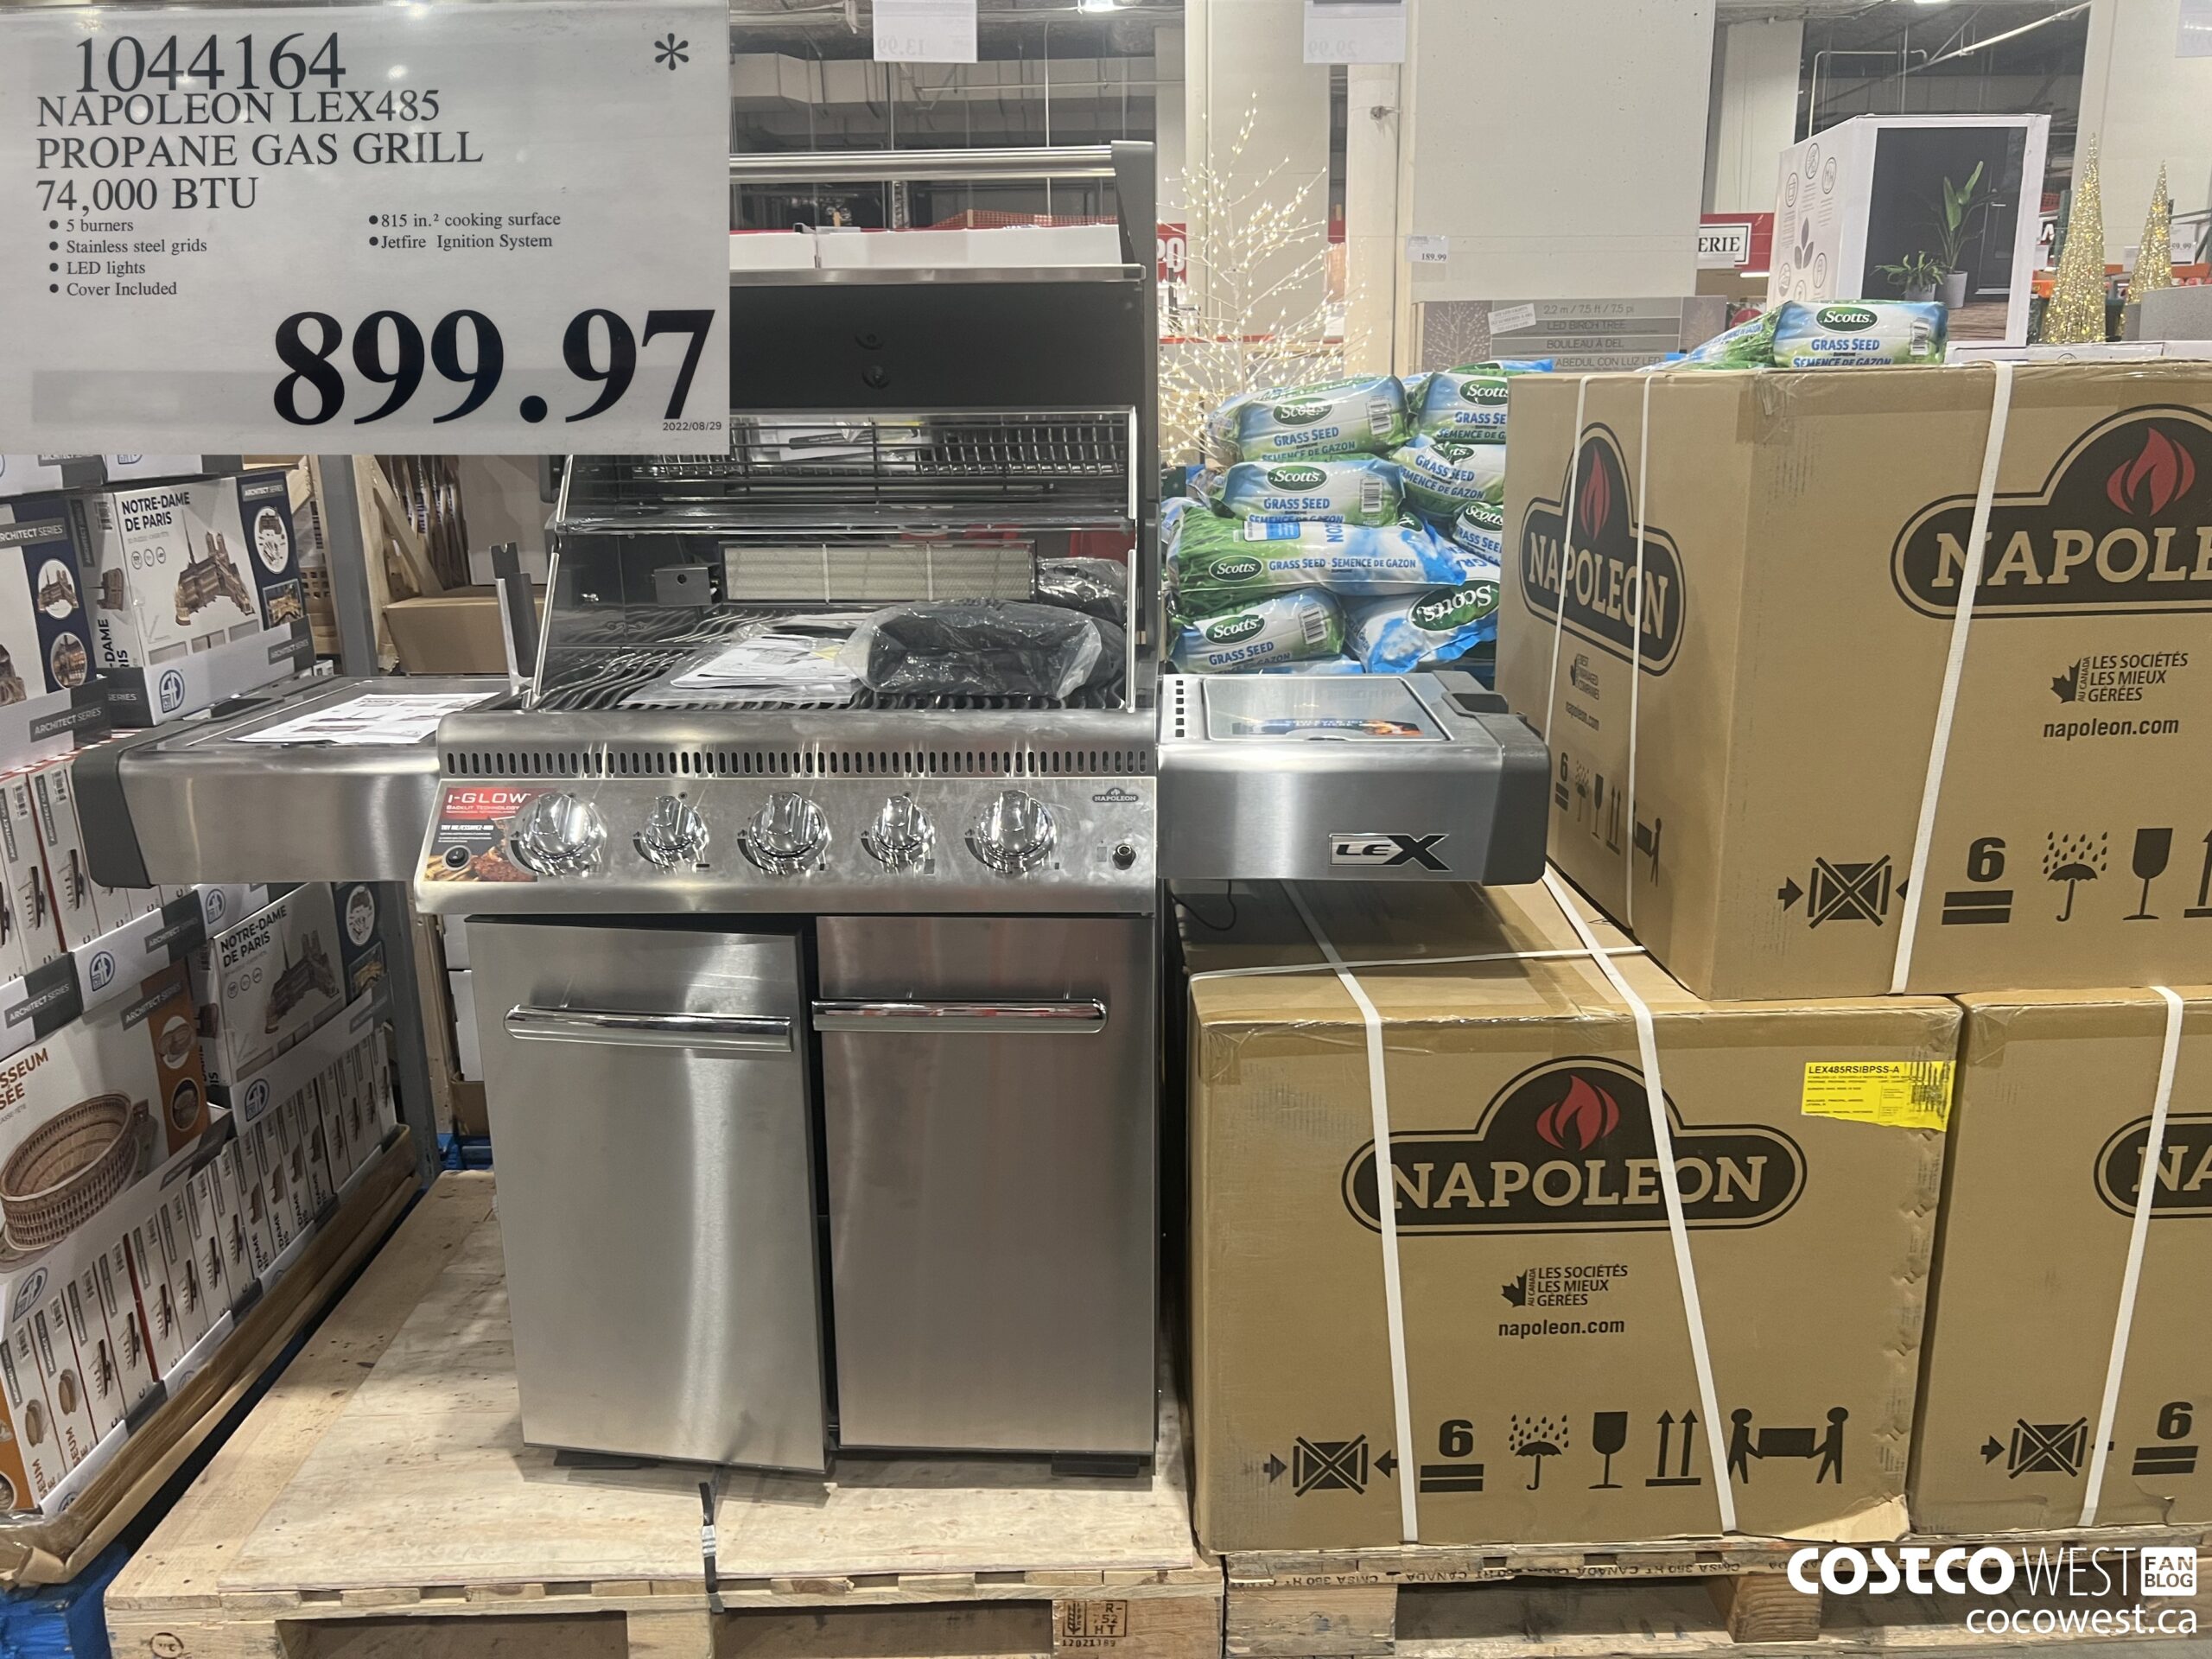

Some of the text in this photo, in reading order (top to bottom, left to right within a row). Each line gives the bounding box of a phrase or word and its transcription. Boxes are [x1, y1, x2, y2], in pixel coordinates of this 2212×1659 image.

[77, 32, 346, 92] 1044164
[36, 88, 440, 127] NAPOLEON LEX485
[36, 130, 483, 170] PROPANE GAS GRILL
[36, 175, 257, 217] 74,000 BTU
[67, 219, 134, 232] 5 burners
[381, 213, 407, 227] 815
[445, 213, 503, 229] cooking
[508, 213, 561, 226] surface
[67, 238, 207, 256] Stainless steel grids
[381, 233, 553, 251] Jetfire Ignition System
[1698, 237, 1740, 252] ERIE
[67, 261, 146, 277] LED lights
[67, 282, 178, 296] Cover Included
[1547, 320, 1626, 330] LED BIRCH TREE
[1823, 311, 1871, 323] Scotts
[1811, 339, 1880, 351] GRASS SEED
[273, 308, 716, 427] 899.97
[1599, 357, 1619, 366] CON
[1455, 411, 1491, 423] GRASS
[663, 422, 722, 432] 2022/08/29
[1436, 429, 1483, 439] SEMENCE
[1274, 432, 1309, 447] GRASS
[1312, 427, 1338, 441] SEED
[1322, 441, 1356, 454] GAZON
[1415, 454, 1450, 477] GRASS
[1274, 469, 1321, 482] Scotts
[1451, 487, 1485, 499] GAZON
[121, 492, 190, 515] NOTRE-DAME
[1263, 498, 1330, 509] GRASS SEED
[124, 512, 172, 532] DE PARIS
[1217, 562, 1255, 575] Scotts
[1269, 560, 1300, 570] GRASS
[1302, 559, 1325, 568] SEED
[1332, 557, 1372, 568] SEMENCE
[1386, 559, 1416, 568] GAZON
[1529, 531, 1669, 639] NAPOLEON
[1213, 618, 1257, 639] Scotts
[1209, 641, 1274, 665] GRASS SEED
[2093, 652, 2189, 669] LES SOCIÉTÉS
[2079, 657, 2091, 690] CANADA
[2090, 670, 2166, 685] LES MIEUX
[2088, 685, 2143, 702] GÉRÉES
[35, 707, 102, 734] ARCHITECT SERIES
[2044, 718, 2179, 741] napoleon.com
[1967, 836, 2007, 883] 6
[219, 905, 287, 953] NOTRE-DAME
[223, 931, 270, 968] DE PARIS
[10, 995, 48, 1022] ARCHITECT
[1389, 1155, 1768, 1210] NAPOLEON
[1538, 1263, 1628, 1279] LES SOCIÉTÉS
[1528, 1268, 1536, 1296] CANADA
[1538, 1280, 1609, 1293] LES MIEUX
[1537, 1293, 1588, 1306] GÉRÉES
[1498, 1319, 1624, 1339] napoleon.com
[2157, 1401, 2192, 1440] 6
[1440, 1419, 1473, 1459] 6
